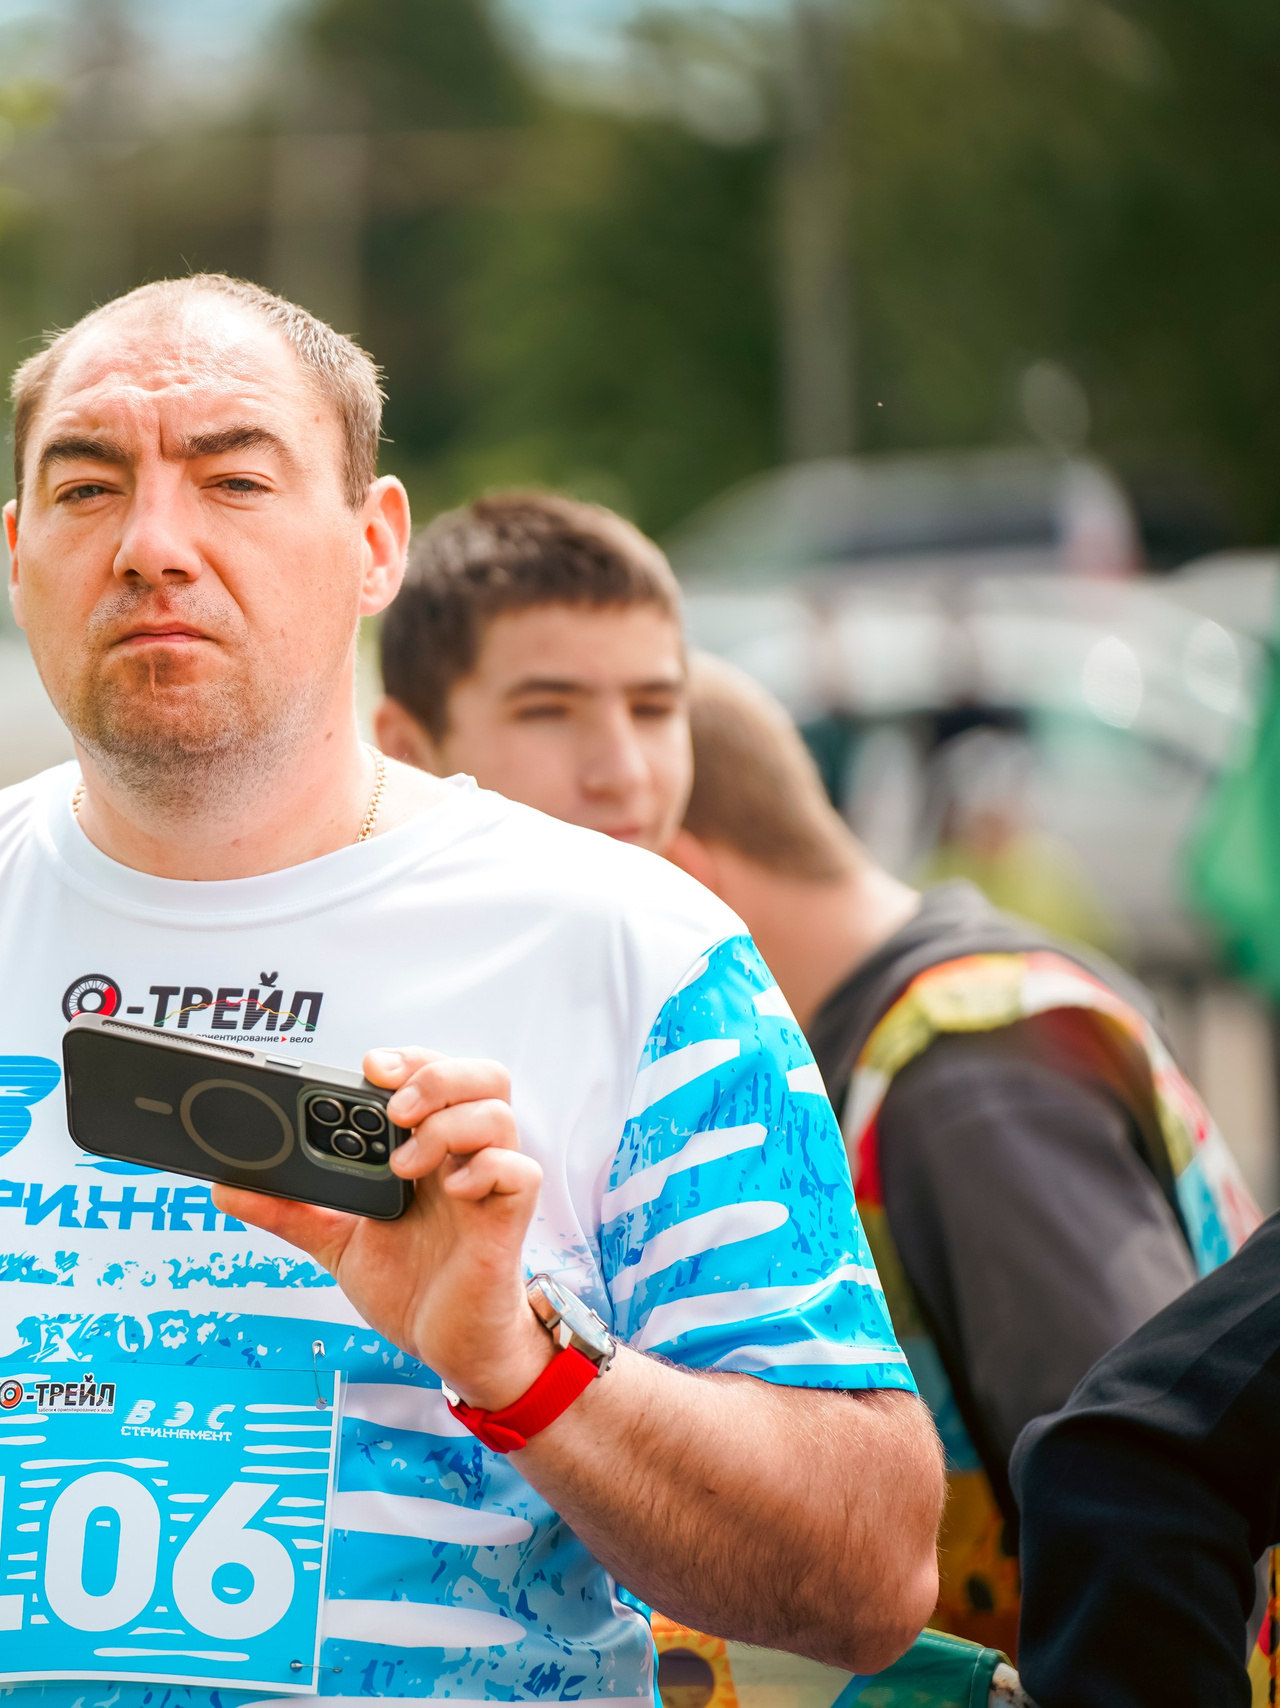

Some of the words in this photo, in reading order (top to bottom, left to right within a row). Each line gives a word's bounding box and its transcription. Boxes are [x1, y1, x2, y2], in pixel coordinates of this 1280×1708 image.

[196, 1033, 279, 1043] иентирование
[289, 1035, 314, 1043] вело
[120, 1426, 233, 1442] СТРИЖАМЕНТ
